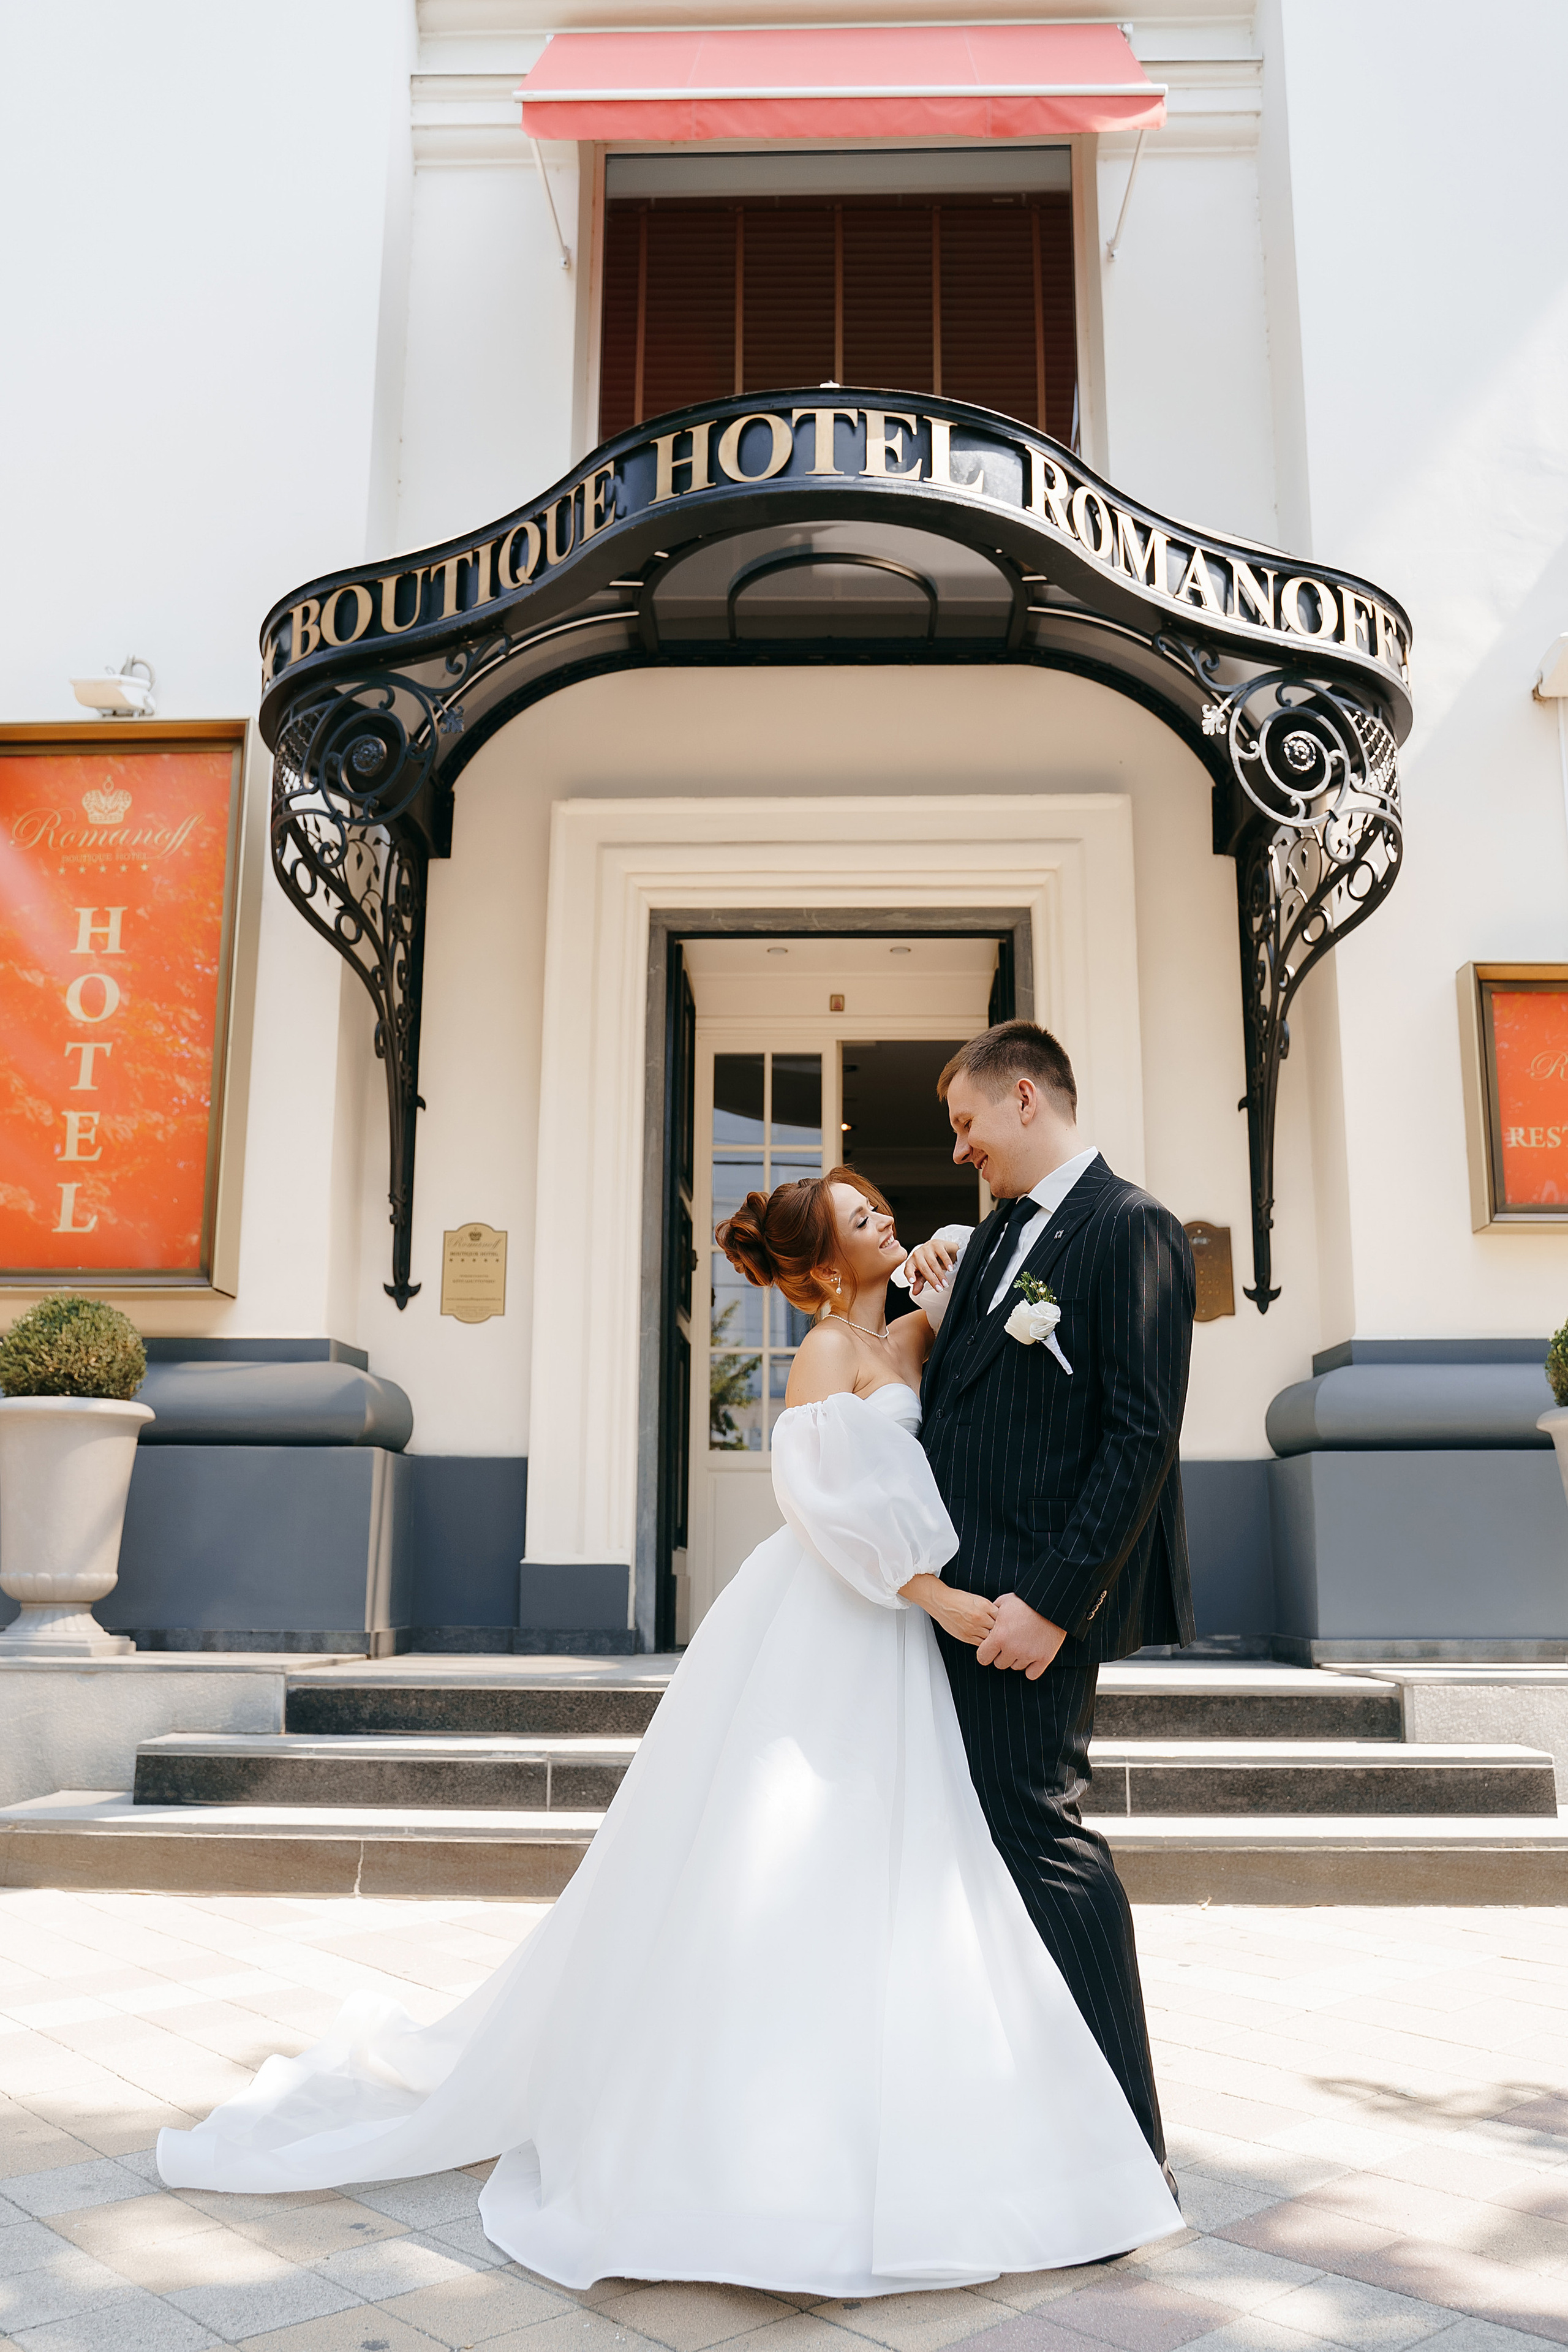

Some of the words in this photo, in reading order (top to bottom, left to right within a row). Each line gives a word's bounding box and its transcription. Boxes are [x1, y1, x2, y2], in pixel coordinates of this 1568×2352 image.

[288, 461, 616, 666] BOUTIQUE
[649, 407, 984, 505] HOTEL
[1024, 445, 1397, 668] ROMANOFF
[9, 807, 206, 859] Romanoff
[52, 906, 128, 1233] HOTEL
